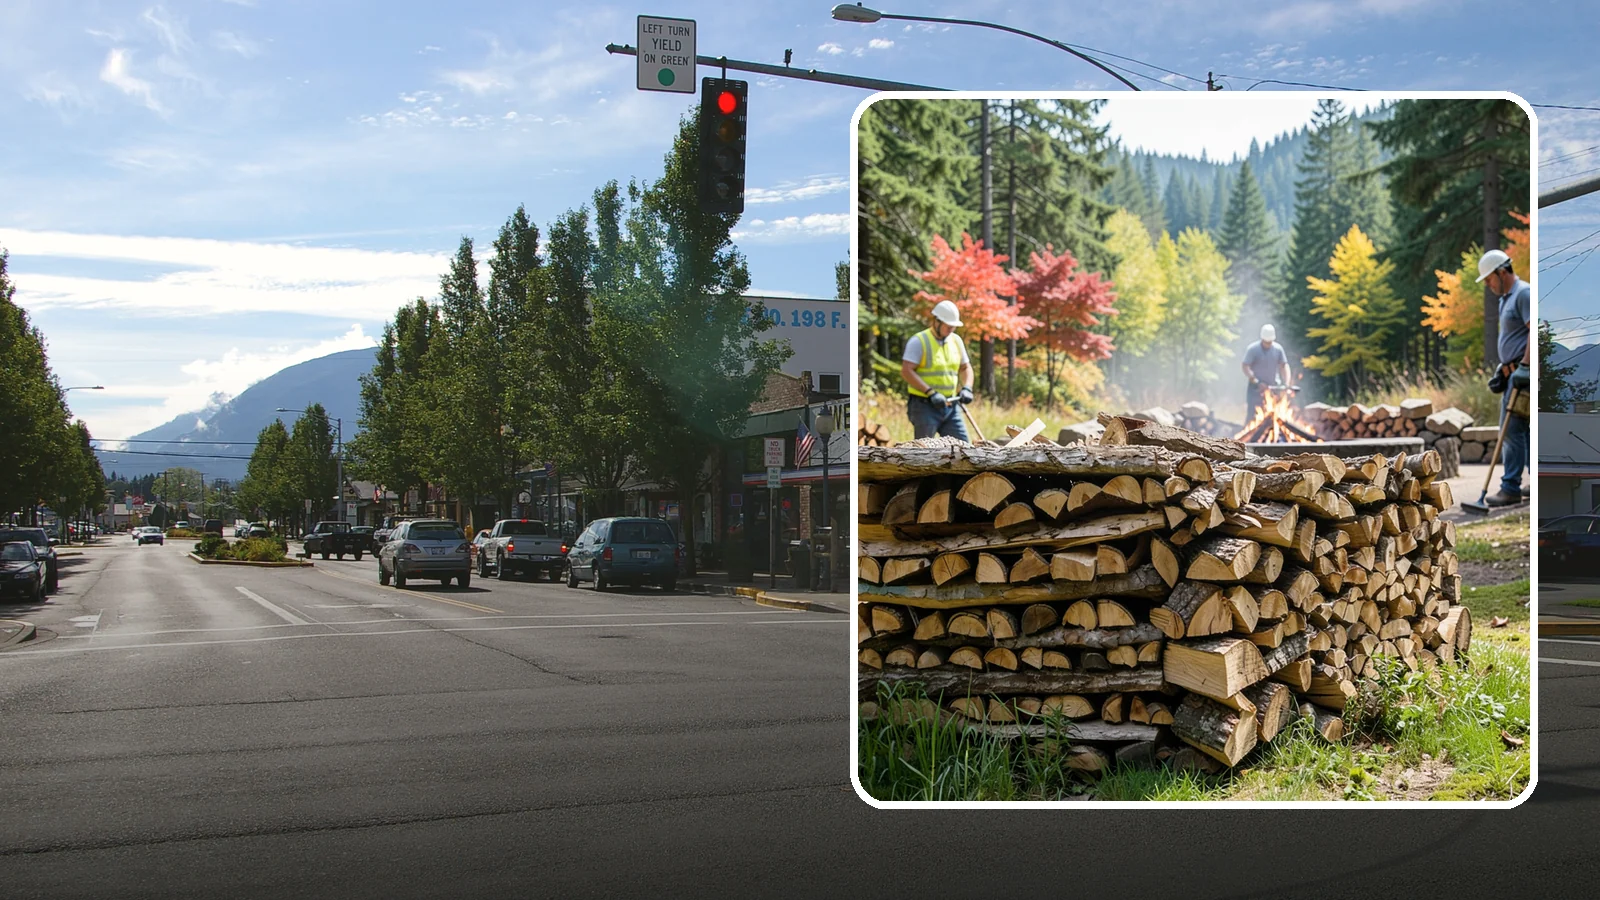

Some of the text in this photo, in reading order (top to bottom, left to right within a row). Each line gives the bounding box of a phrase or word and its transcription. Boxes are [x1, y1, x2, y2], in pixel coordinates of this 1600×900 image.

[643, 24, 690, 36] LEFT TURN
[652, 38, 682, 51] YIELD
[644, 53, 688, 66] ON GREEN
[791, 309, 826, 328] 198
[831, 311, 846, 329] F.
